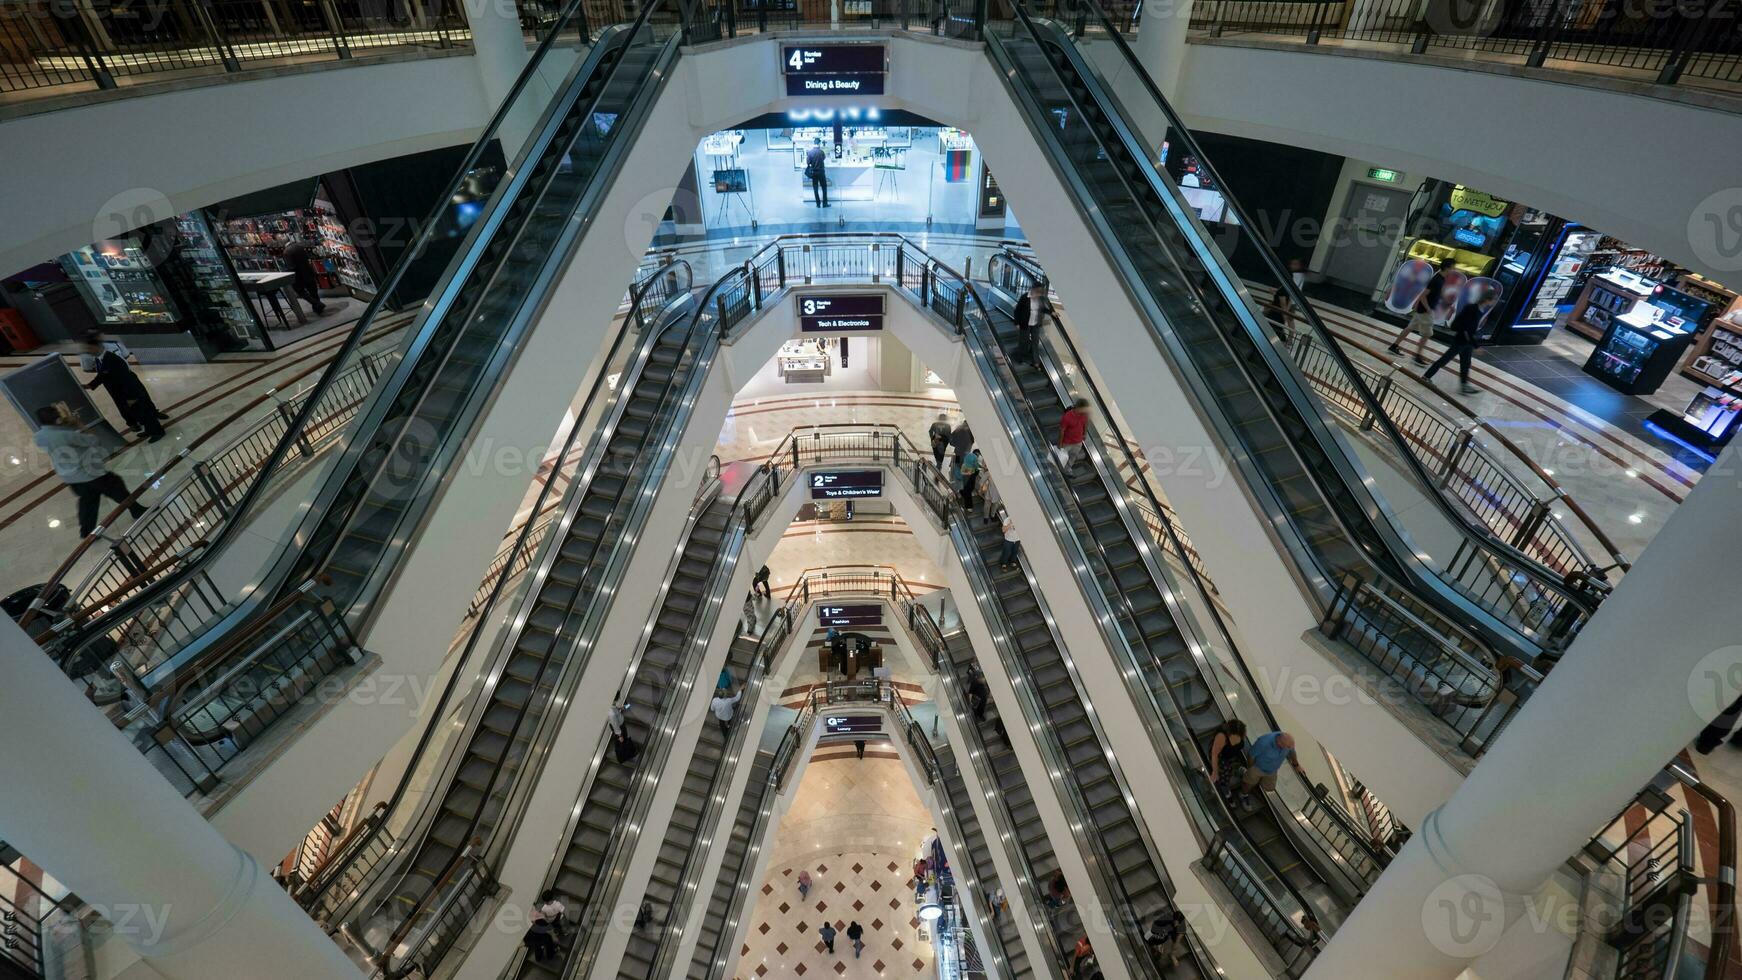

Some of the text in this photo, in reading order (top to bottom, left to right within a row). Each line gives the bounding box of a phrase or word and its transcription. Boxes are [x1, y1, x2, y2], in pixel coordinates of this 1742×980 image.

[789, 49, 803, 70] 4
[805, 80, 860, 90] Dining & Beauty
[1464, 198, 1485, 207] MEET
[804, 299, 815, 315] 3
[814, 475, 824, 486] 2
[823, 608, 829, 617] 1
